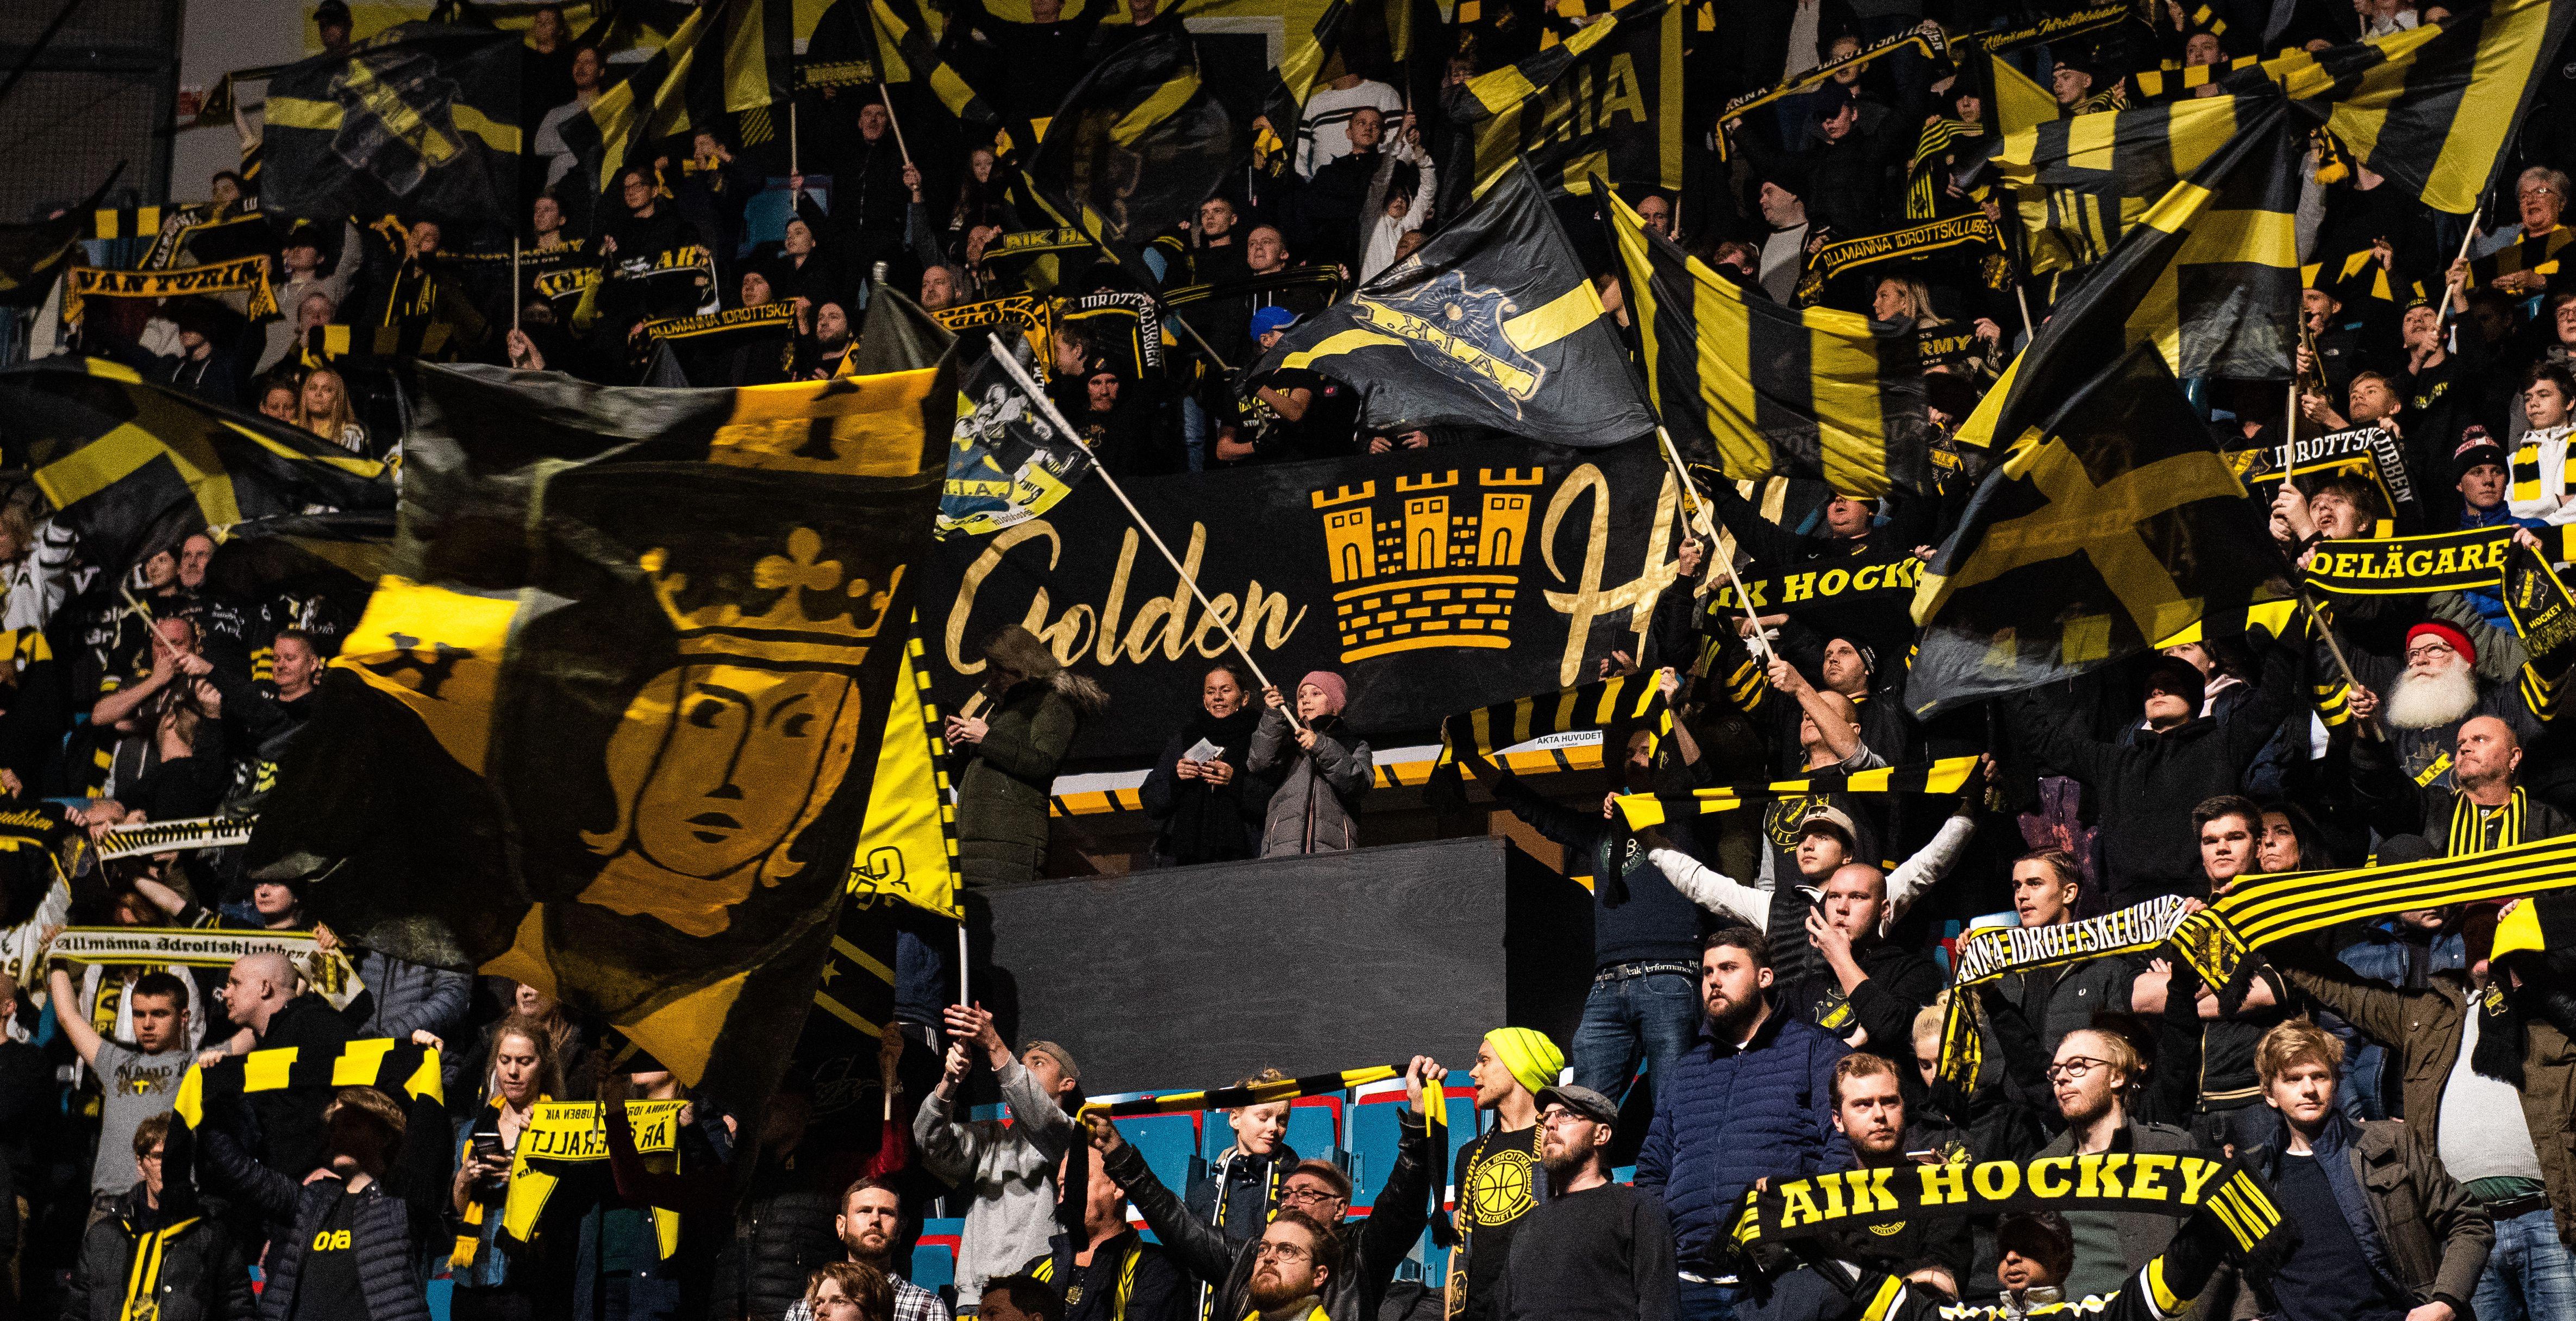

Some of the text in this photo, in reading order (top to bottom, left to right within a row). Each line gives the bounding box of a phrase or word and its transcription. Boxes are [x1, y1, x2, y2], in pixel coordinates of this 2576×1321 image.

[2309, 539, 2510, 579] DELÄGARE
[946, 519, 1308, 722] Golden
[2529, 602, 2561, 629] HOCKEY
[1537, 732, 1602, 744] AKTA HUVUDET
[55, 936, 151, 951] Allmänna
[1780, 1153, 2222, 1228] AIK HOCKEY
[1481, 1211, 1510, 1223] BASKET
